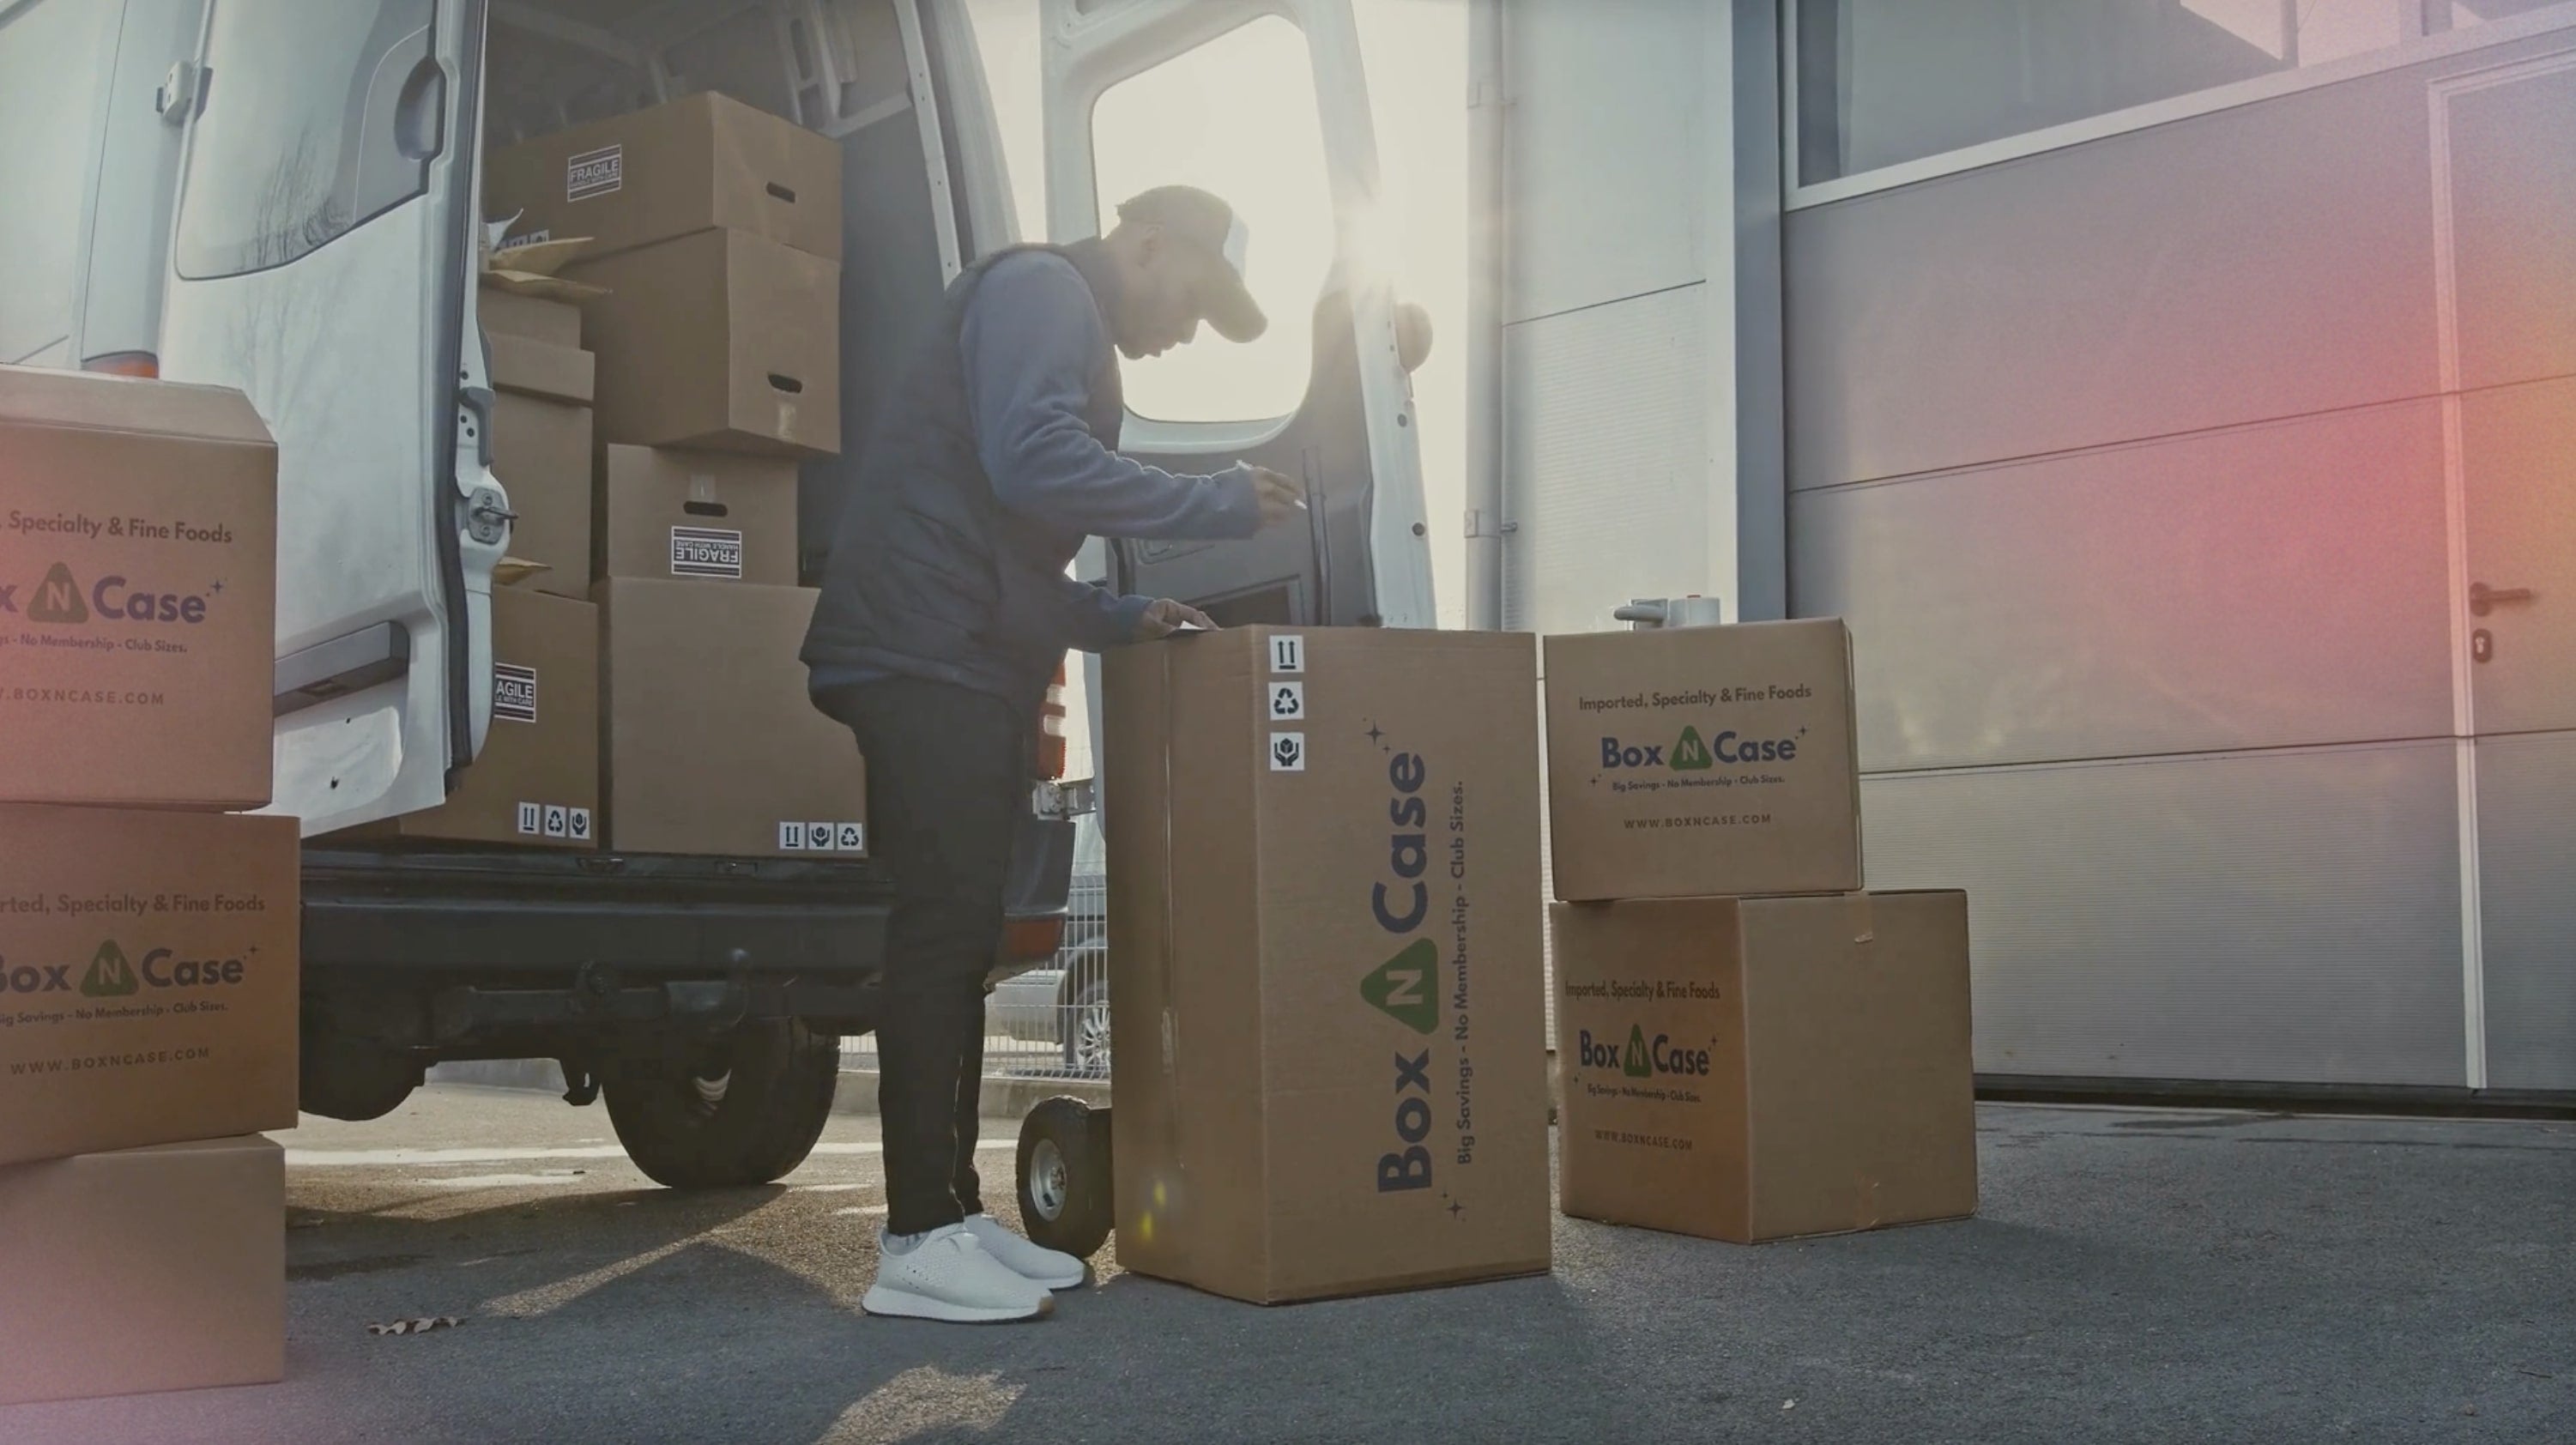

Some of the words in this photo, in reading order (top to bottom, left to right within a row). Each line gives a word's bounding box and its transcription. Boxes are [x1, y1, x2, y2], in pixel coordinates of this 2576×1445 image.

[571, 159, 619, 183] FRAGILE
[8, 511, 102, 539] Specialty
[108, 517, 124, 535] &
[129, 518, 169, 540] Fine
[175, 522, 233, 543] Foods
[675, 547, 738, 563] FRAGILE
[47, 581, 71, 613] N
[92, 575, 207, 624] Case
[21, 633, 39, 646] No
[40, 634, 114, 652] Membership
[124, 638, 152, 651] Club
[154, 640, 188, 653] Sizes.
[0, 687, 164, 705] .BOXNCASE.COM
[496, 680, 533, 698] AGILE
[1579, 693, 1648, 714] Imported,
[1653, 690, 1716, 710] Specialty
[1720, 689, 1732, 703] &
[1735, 687, 1764, 702] Fine
[1769, 684, 1812, 700] Foods
[1601, 736, 1664, 769] Box
[1683, 740, 1700, 762] N
[1714, 731, 1797, 764] Case
[1612, 781, 1626, 793] Big
[1628, 779, 1660, 791] Savings
[1667, 779, 1679, 789] No
[1681, 777, 1732, 789] Membership
[1740, 776, 1759, 786] Club
[1761, 774, 1785, 784] Sizes.
[1450, 781, 1464, 831] Sizes.
[1624, 813, 1771, 829] WWW.BOXNCASE.COM
[1372, 752, 1430, 935] Case
[1450, 837, 1465, 880] Club
[1, 893, 50, 916] rted,
[57, 893, 147, 917] Specialty
[153, 895, 169, 911] &
[172, 895, 210, 911] Fine
[215, 894, 265, 911] Foods
[1451, 895, 1470, 1010] Membership
[0, 954, 71, 994] ox
[99, 958, 121, 985] N
[142, 947, 245, 988] Case
[1387, 969, 1423, 1005] N
[1565, 981, 1610, 1001] Imported,
[1612, 980, 1654, 1002] Specialty
[1656, 982, 1666, 999] &
[1667, 981, 1687, 999] Fine
[1689, 981, 1720, 1000] Foods
[0, 1013, 15, 1027] ig
[17, 1010, 64, 1025] Savings
[76, 1009, 93, 1020] No
[95, 1004, 164, 1019] Membership
[173, 1002, 197, 1014] Club
[200, 1001, 228, 1013] Sizes.
[1455, 1013, 1469, 1041] No
[11, 1048, 209, 1074] WWW.BOXNCASE.COM
[1580, 1030, 1621, 1067] Box
[1632, 1043, 1643, 1067] N
[1653, 1033, 1710, 1076] Case
[1456, 1057, 1473, 1131] Savings
[1376, 1048, 1432, 1194] Box
[1457, 1134, 1475, 1164] Big
